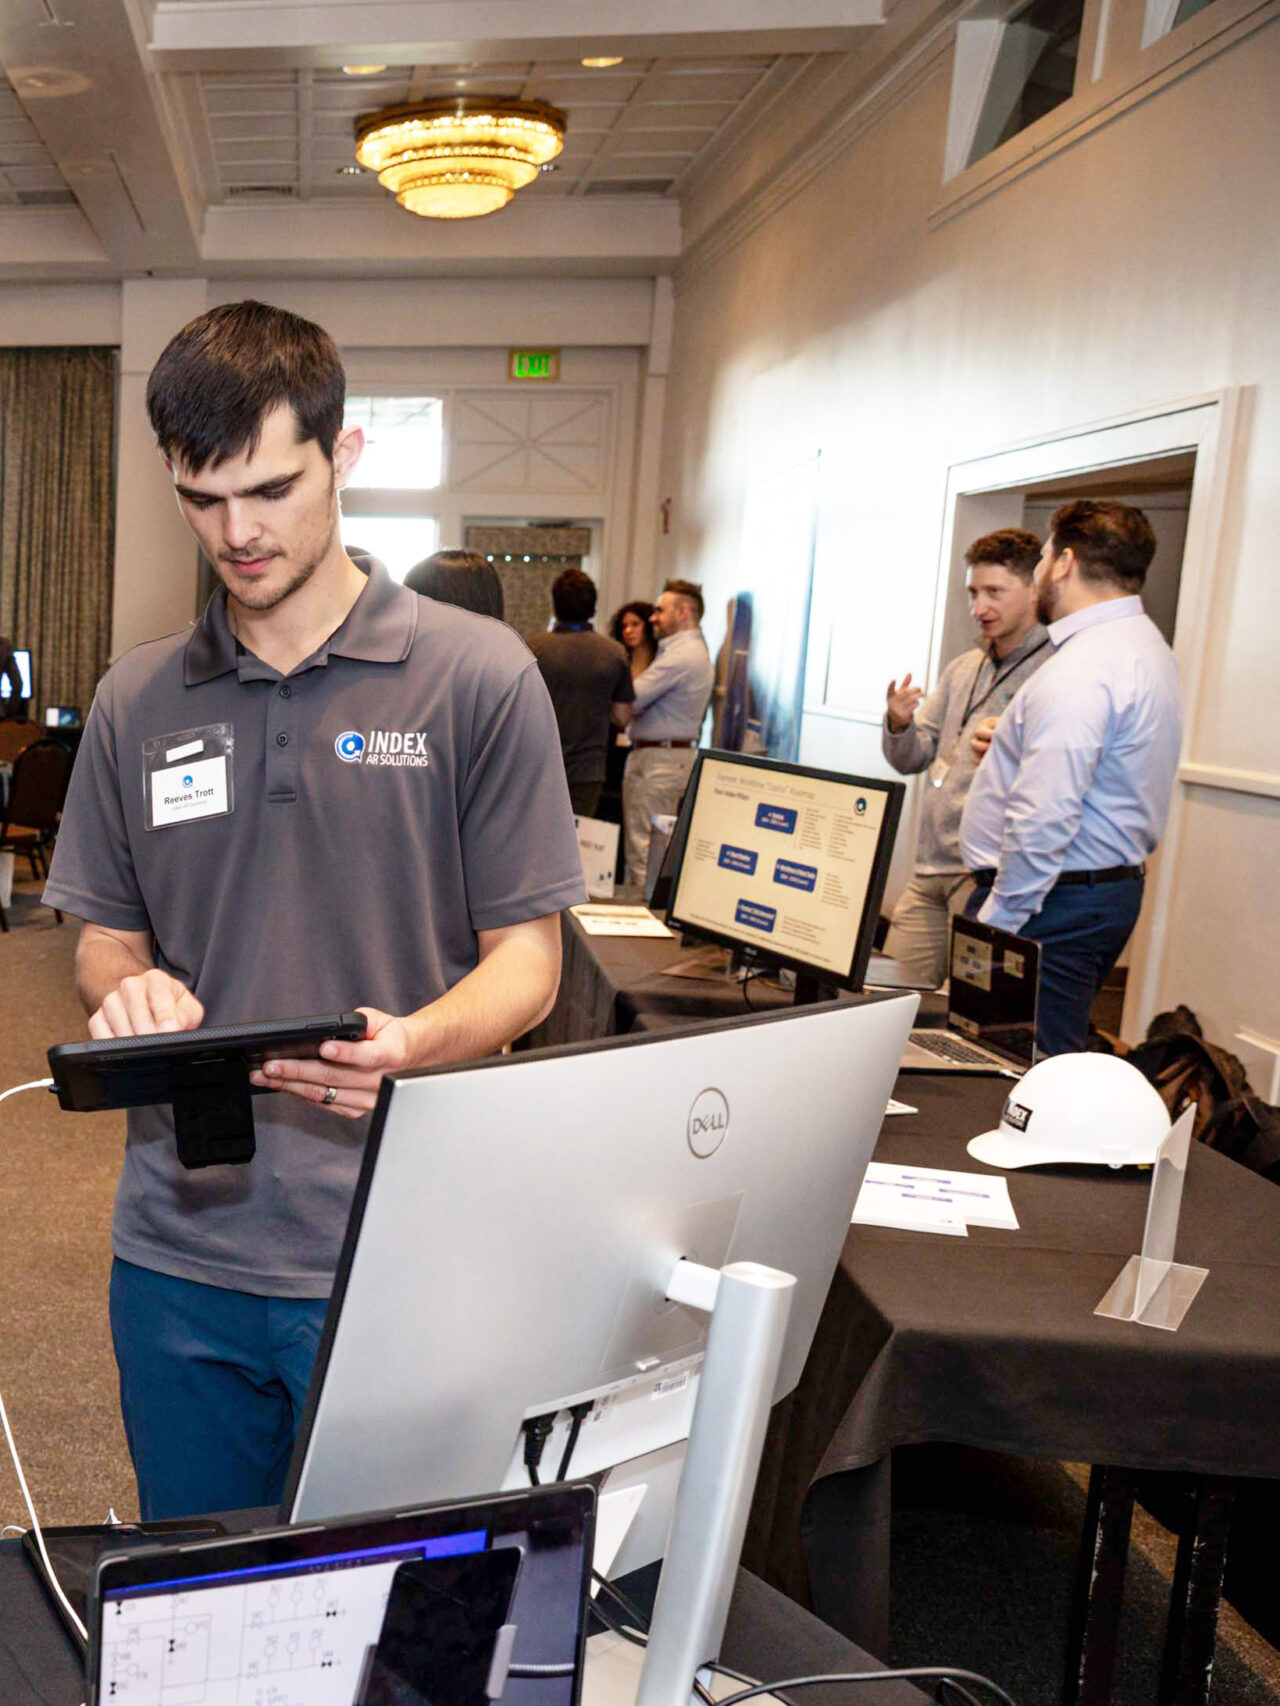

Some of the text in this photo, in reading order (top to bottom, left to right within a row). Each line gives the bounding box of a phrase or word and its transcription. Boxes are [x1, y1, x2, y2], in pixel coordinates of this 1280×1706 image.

[517, 354, 552, 376] EXIT
[368, 731, 427, 755] INDEX
[366, 754, 428, 767] AR SOLUTIONS
[164, 788, 214, 805] Reeves Trott
[693, 1112, 724, 1135] DELL
